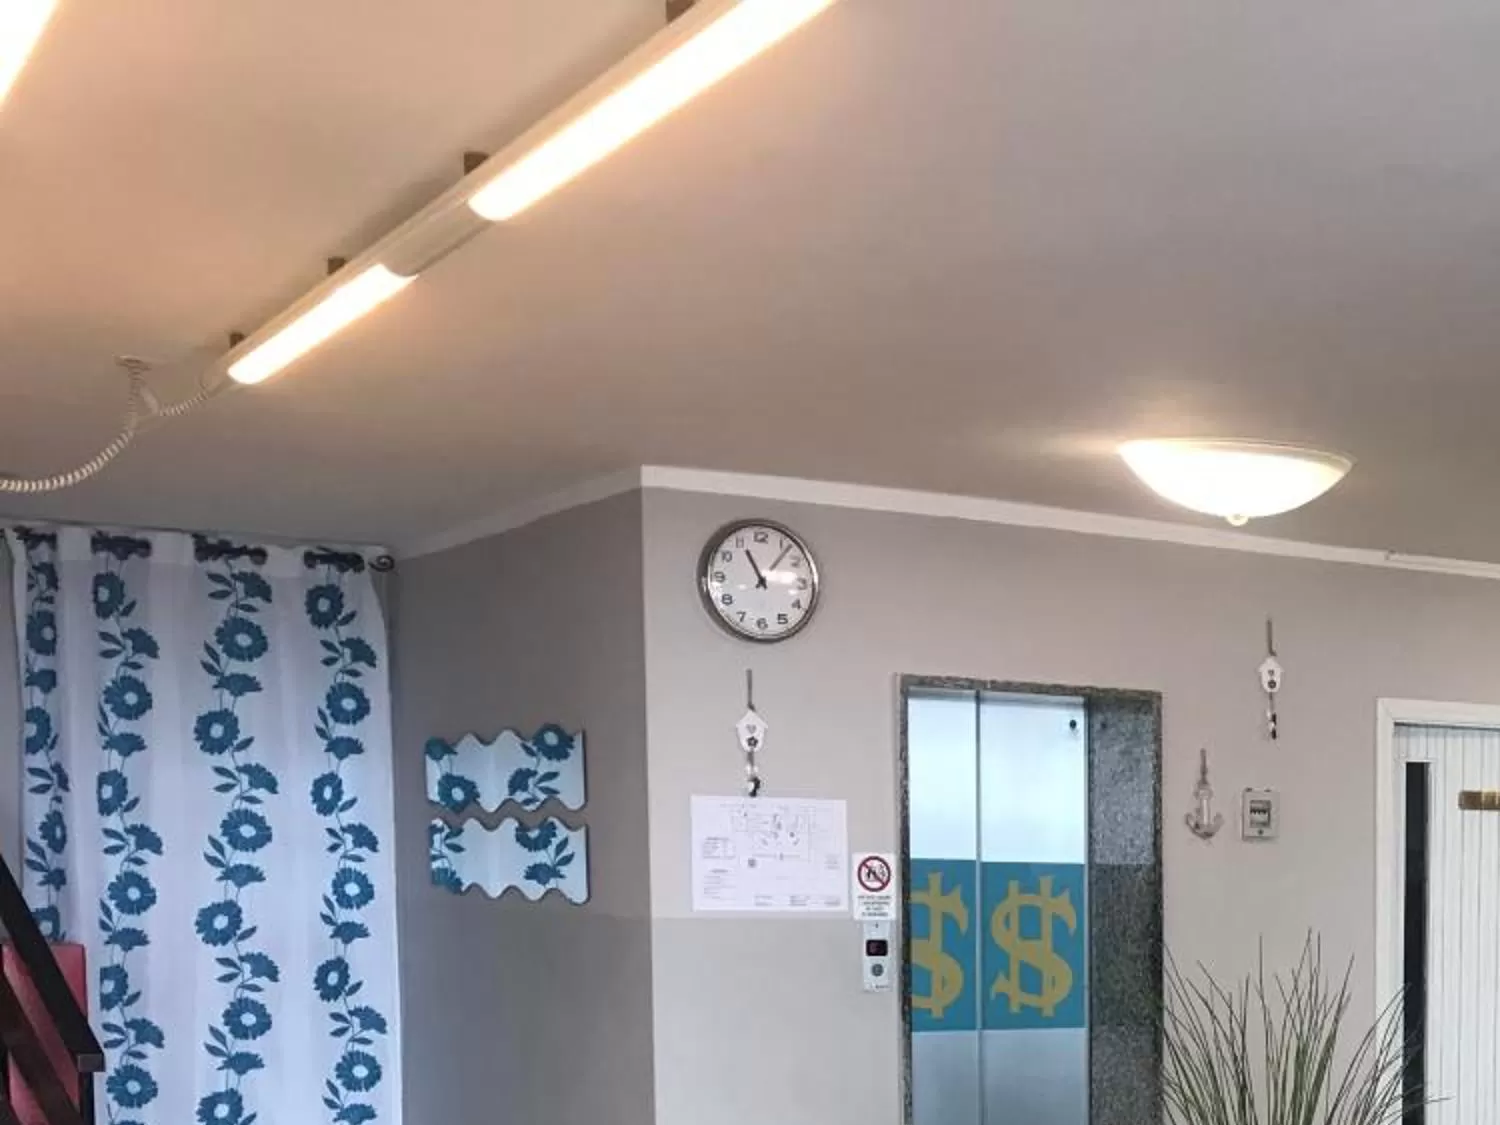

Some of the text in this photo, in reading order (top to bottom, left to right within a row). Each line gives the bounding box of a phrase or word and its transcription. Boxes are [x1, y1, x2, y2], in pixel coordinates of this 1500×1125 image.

[736, 611, 747, 622] 7
[777, 613, 788, 625] 5
[756, 617, 769, 630] 6
